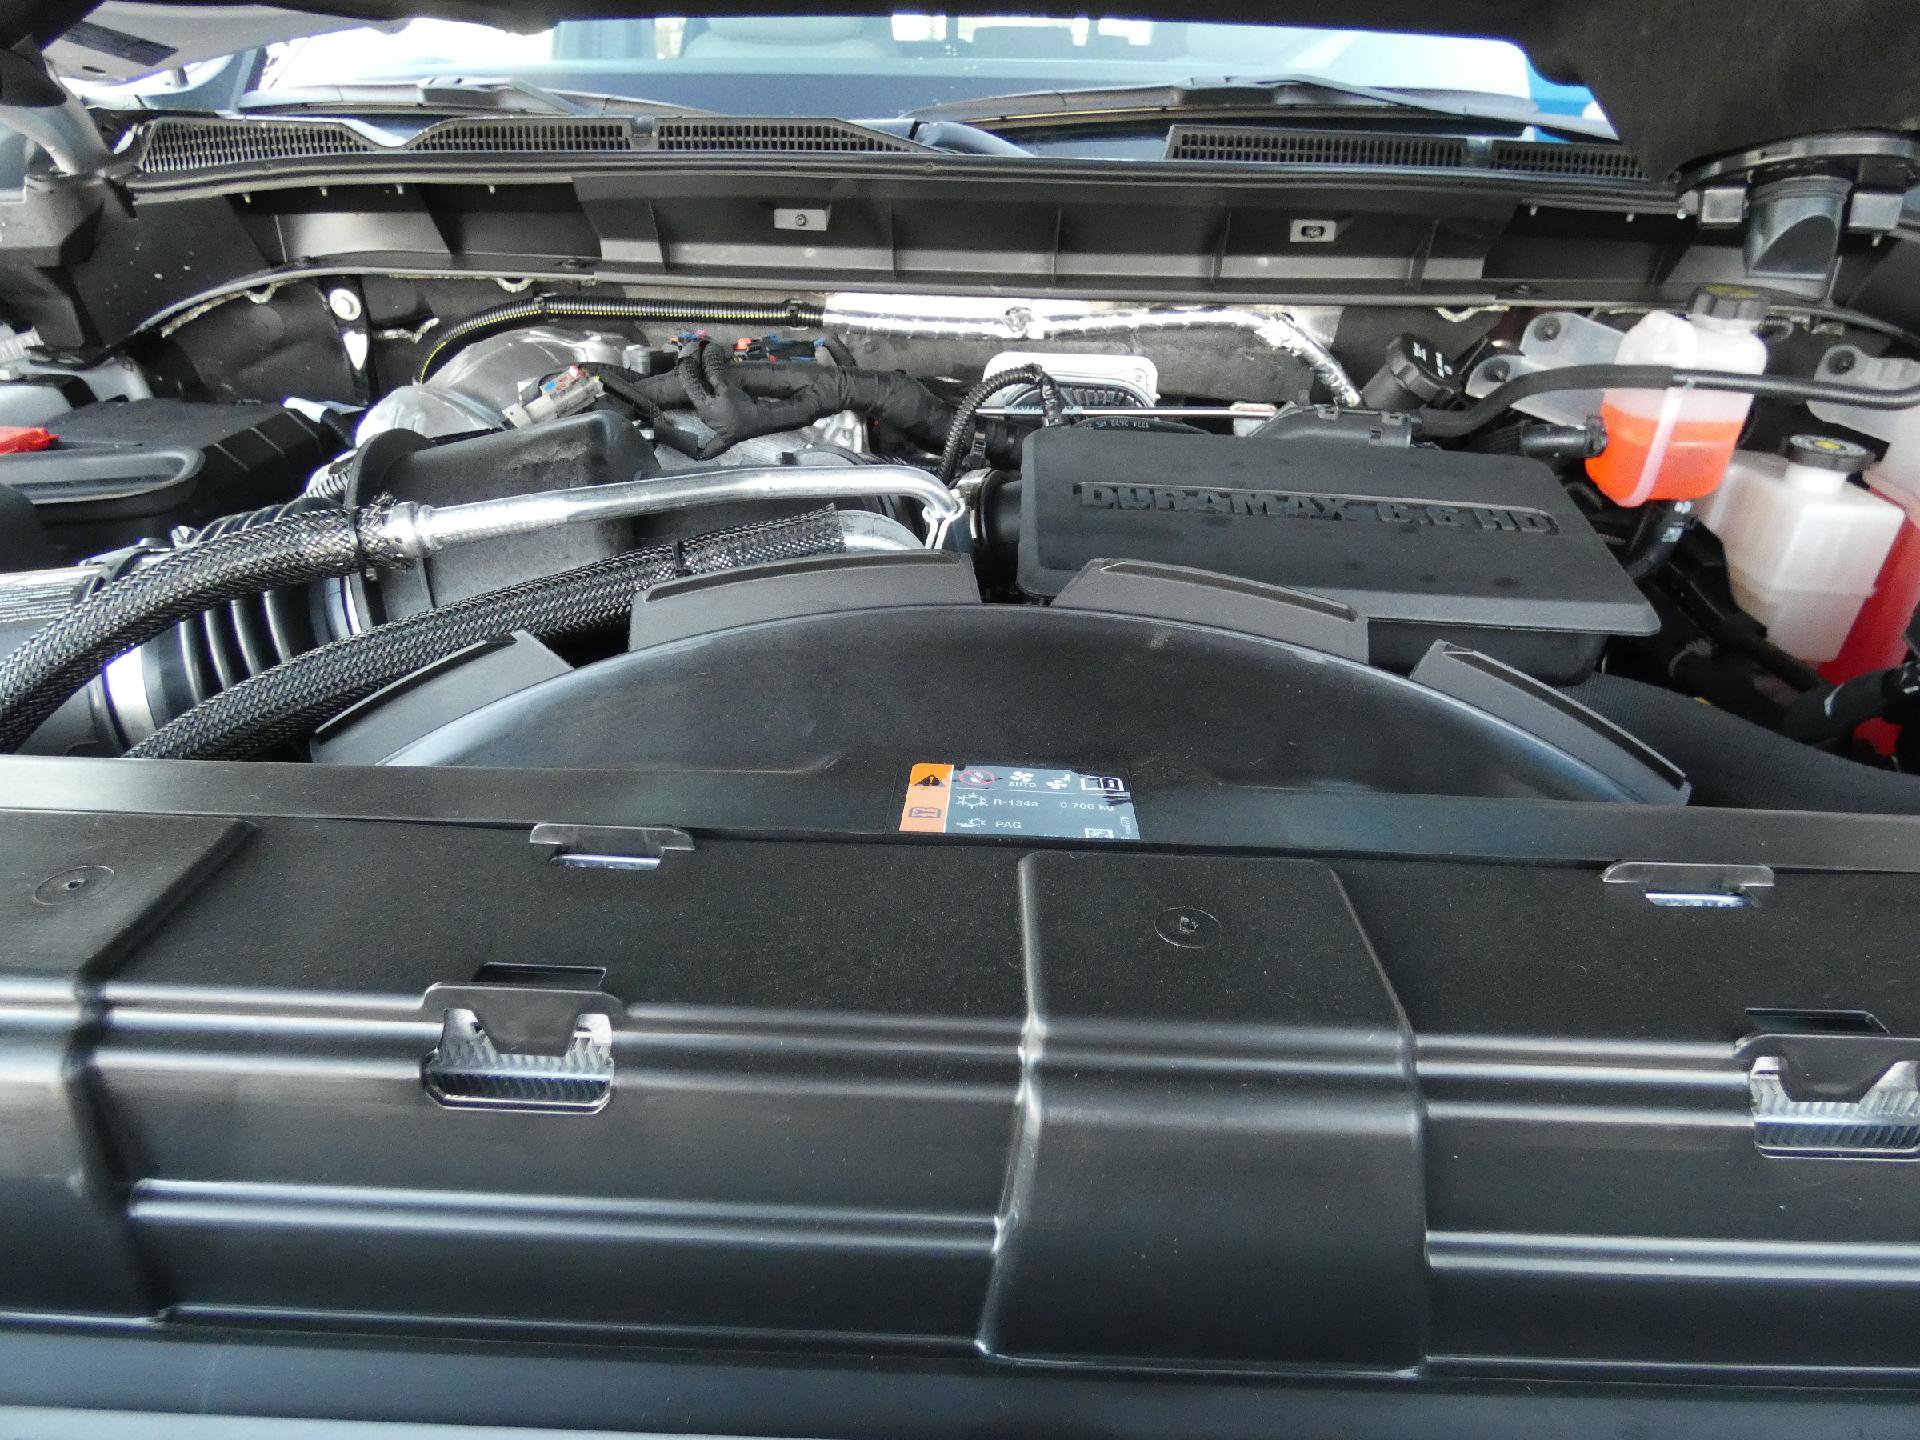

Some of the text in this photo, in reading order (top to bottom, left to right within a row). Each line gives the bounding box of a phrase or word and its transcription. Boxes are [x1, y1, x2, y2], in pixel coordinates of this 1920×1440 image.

[1078, 484, 1554, 533] DURAMAX 6.6 HD
[993, 798, 1039, 807] R-134a
[1060, 801, 1095, 810] 0700
[995, 821, 1022, 829] PAG
